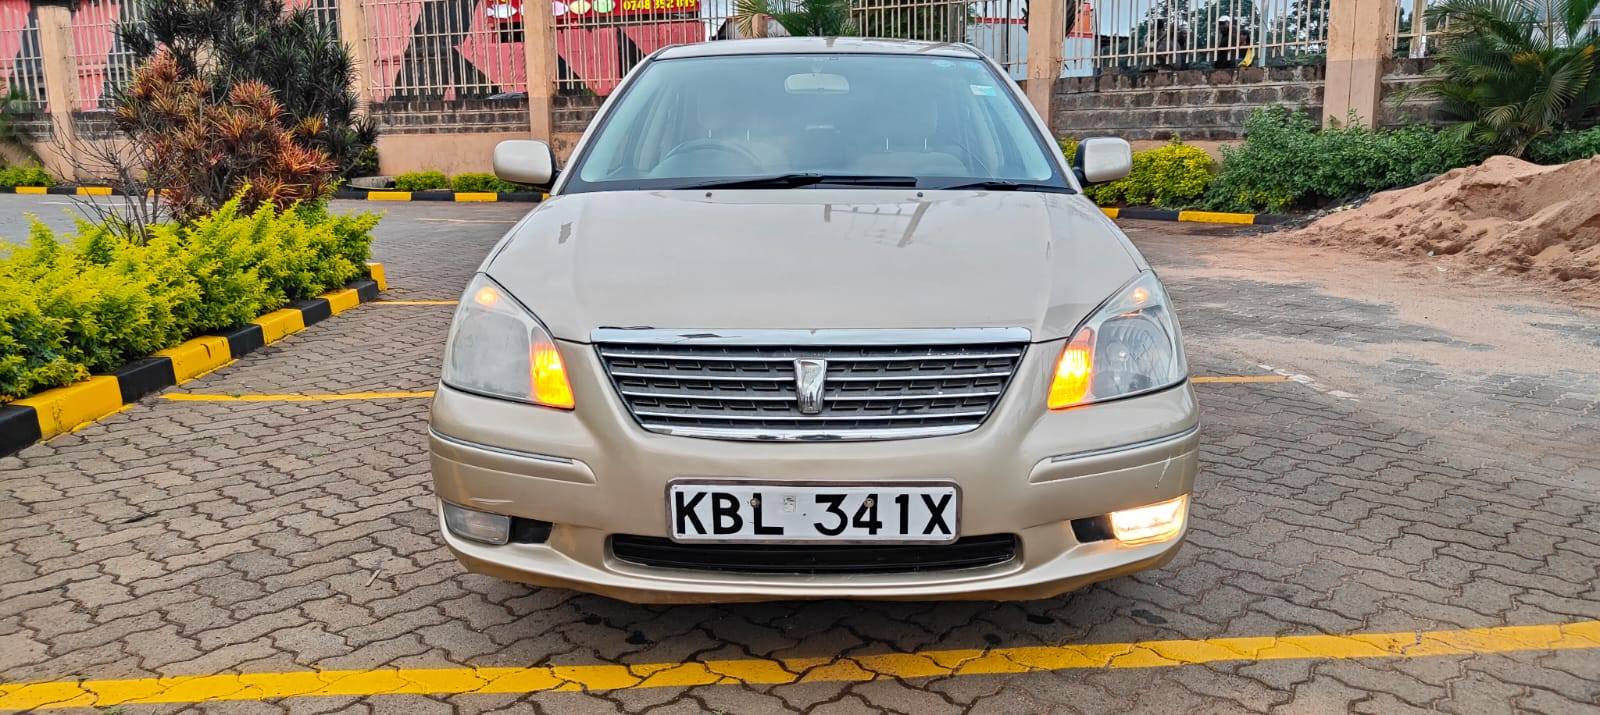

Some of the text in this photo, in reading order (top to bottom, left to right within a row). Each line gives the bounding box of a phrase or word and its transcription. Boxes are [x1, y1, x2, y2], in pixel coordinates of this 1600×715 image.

[623, 0, 651, 10] 0748
[675, 491, 953, 536] KBL 341X
